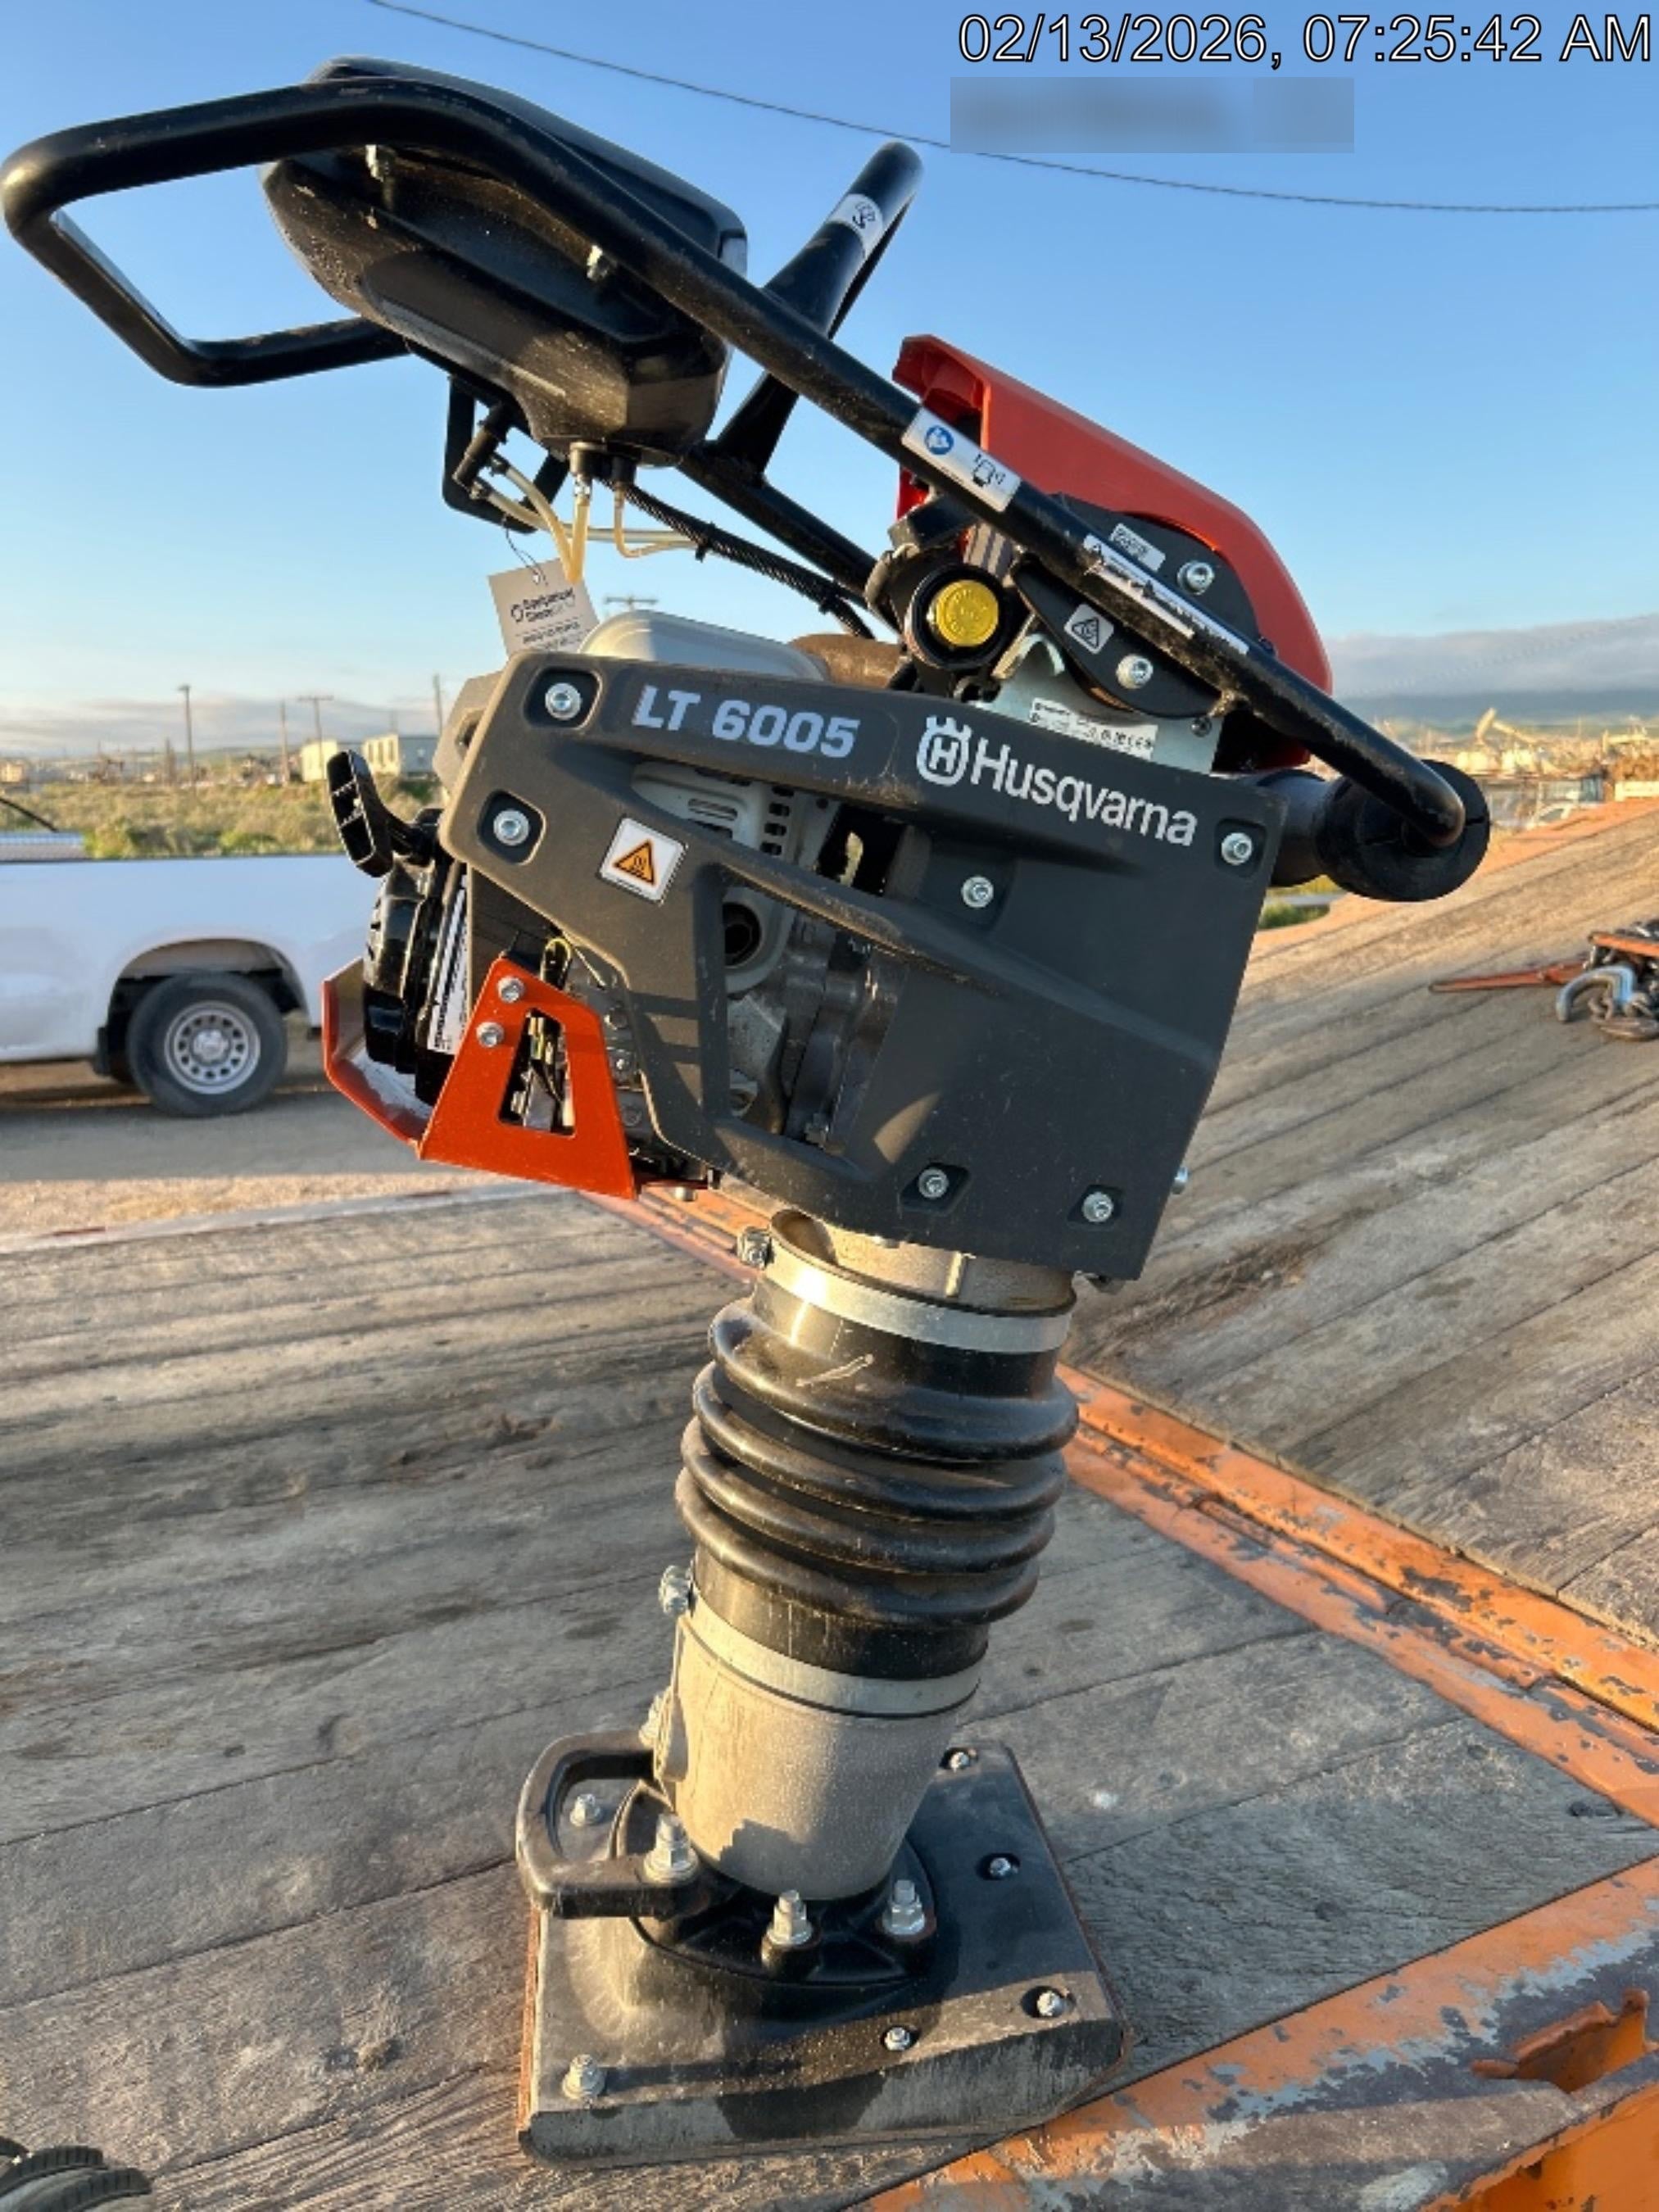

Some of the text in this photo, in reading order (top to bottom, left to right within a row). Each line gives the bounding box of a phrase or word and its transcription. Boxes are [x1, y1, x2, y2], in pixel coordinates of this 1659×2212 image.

[632, 685, 861, 759] LT 6005
[970, 737, 1198, 847] Husqvarna
